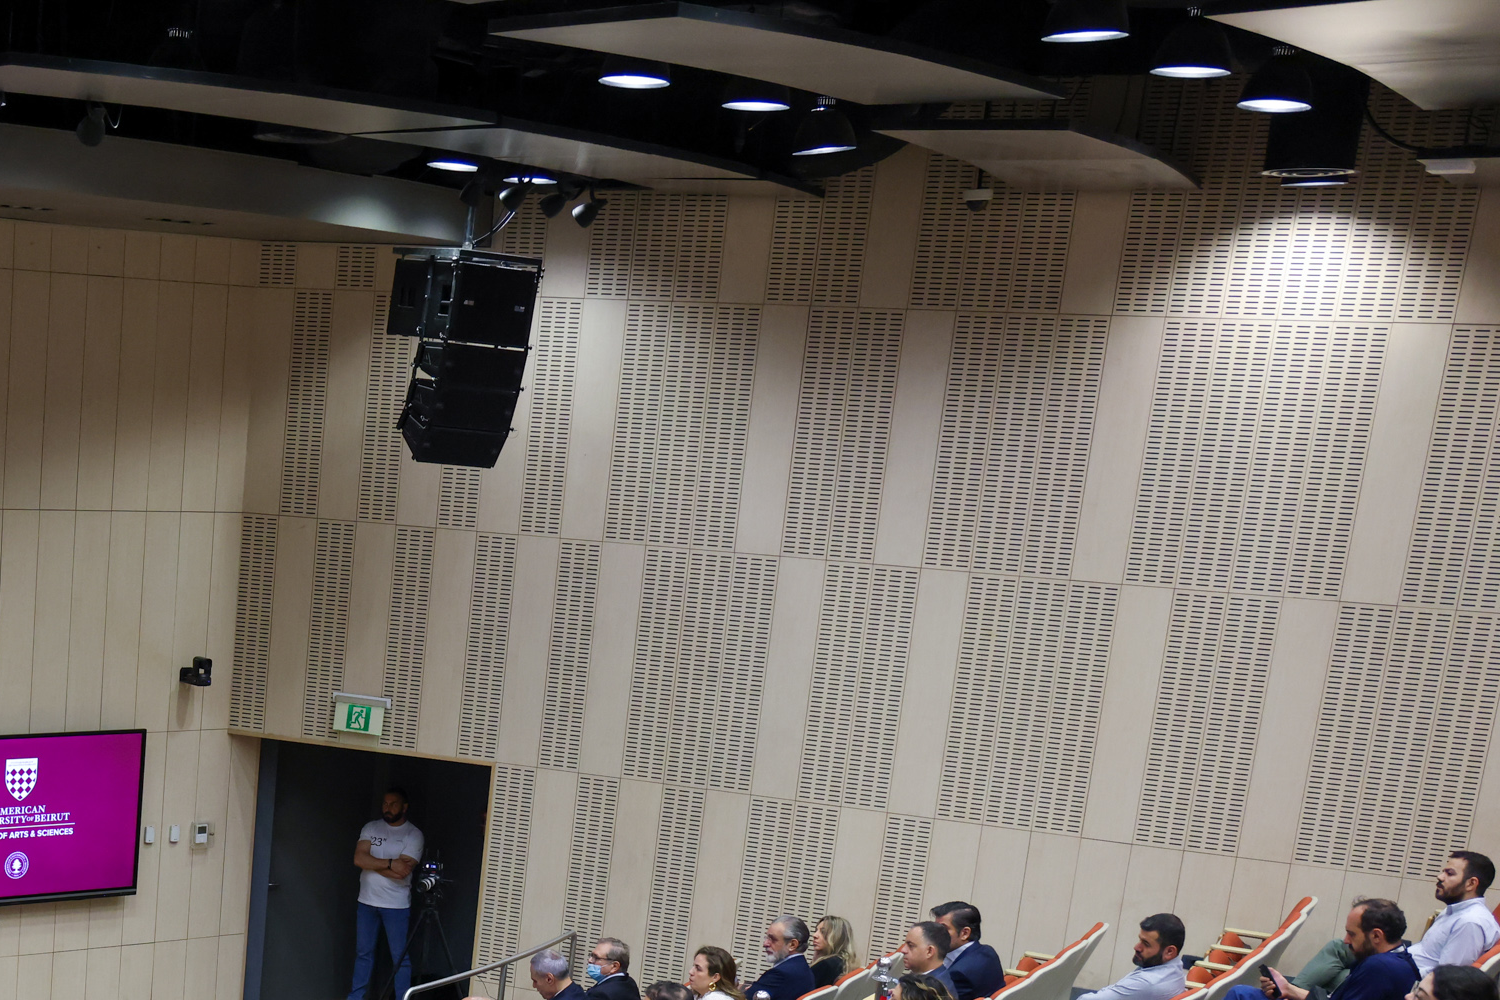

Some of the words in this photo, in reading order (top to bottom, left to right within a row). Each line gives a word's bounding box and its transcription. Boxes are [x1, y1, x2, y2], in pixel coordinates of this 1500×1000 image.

[34, 812, 70, 823] BEIRUT
[9, 830, 29, 839] ARTS
[37, 827, 74, 837] SCIENCES
